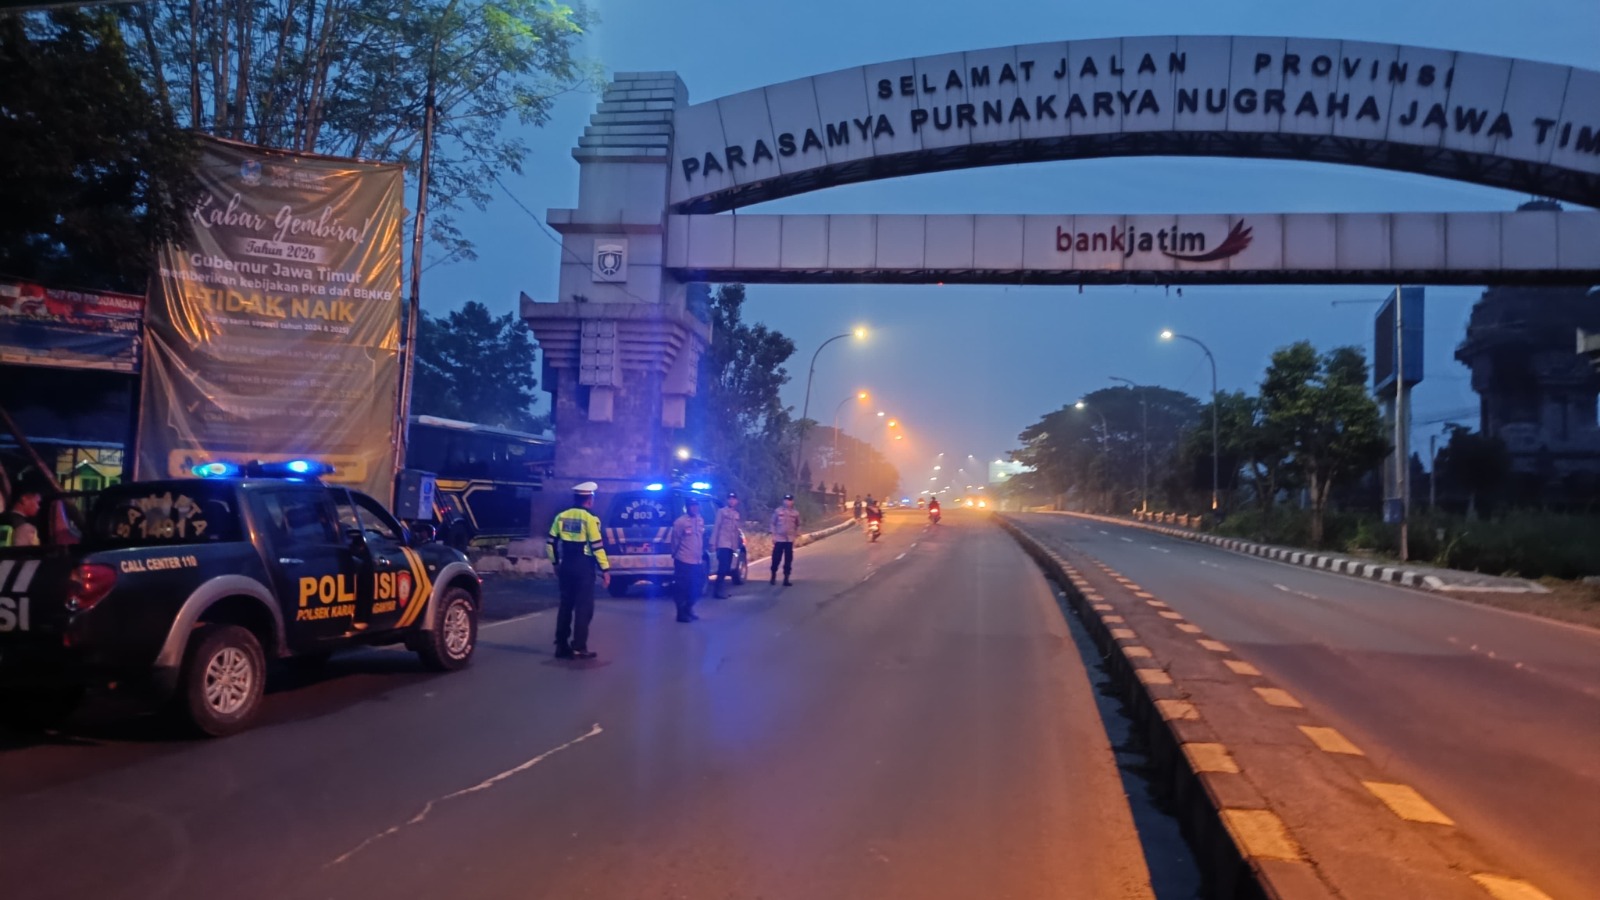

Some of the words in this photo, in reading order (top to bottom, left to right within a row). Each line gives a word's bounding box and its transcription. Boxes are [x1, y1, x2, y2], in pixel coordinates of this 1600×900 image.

[877, 59, 1035, 99] SELAMAT
[1053, 52, 1187, 80] JALAN
[1253, 51, 1456, 88] PROVINSI
[681, 113, 895, 183] PARASAMYA
[910, 88, 1161, 134] PURNAKARYA
[1176, 87, 1381, 123] NUGRAHA
[1399, 99, 1514, 140] JAWA
[192, 192, 267, 231] Kabar
[273, 204, 370, 244] Gembira!
[245, 240, 284, 257] Tahun
[286, 245, 316, 260] 2026
[1055, 224, 1206, 259] bankjatim
[190, 252, 269, 275] Gubernur
[272, 262, 313, 280] Jawa
[316, 265, 362, 284] Timur
[199, 286, 287, 320] TIDAK
[291, 296, 356, 323] NAIK
[239, 276, 299, 295] kebijakan
[301, 284, 326, 296] PKB
[329, 285, 350, 298] dan
[353, 287, 392, 302] BBNKB
[120, 558, 147, 574] CALL
[146, 556, 181, 571] CENTER
[181, 555, 198, 568] 110
[295, 605, 330, 622] POLSEK
